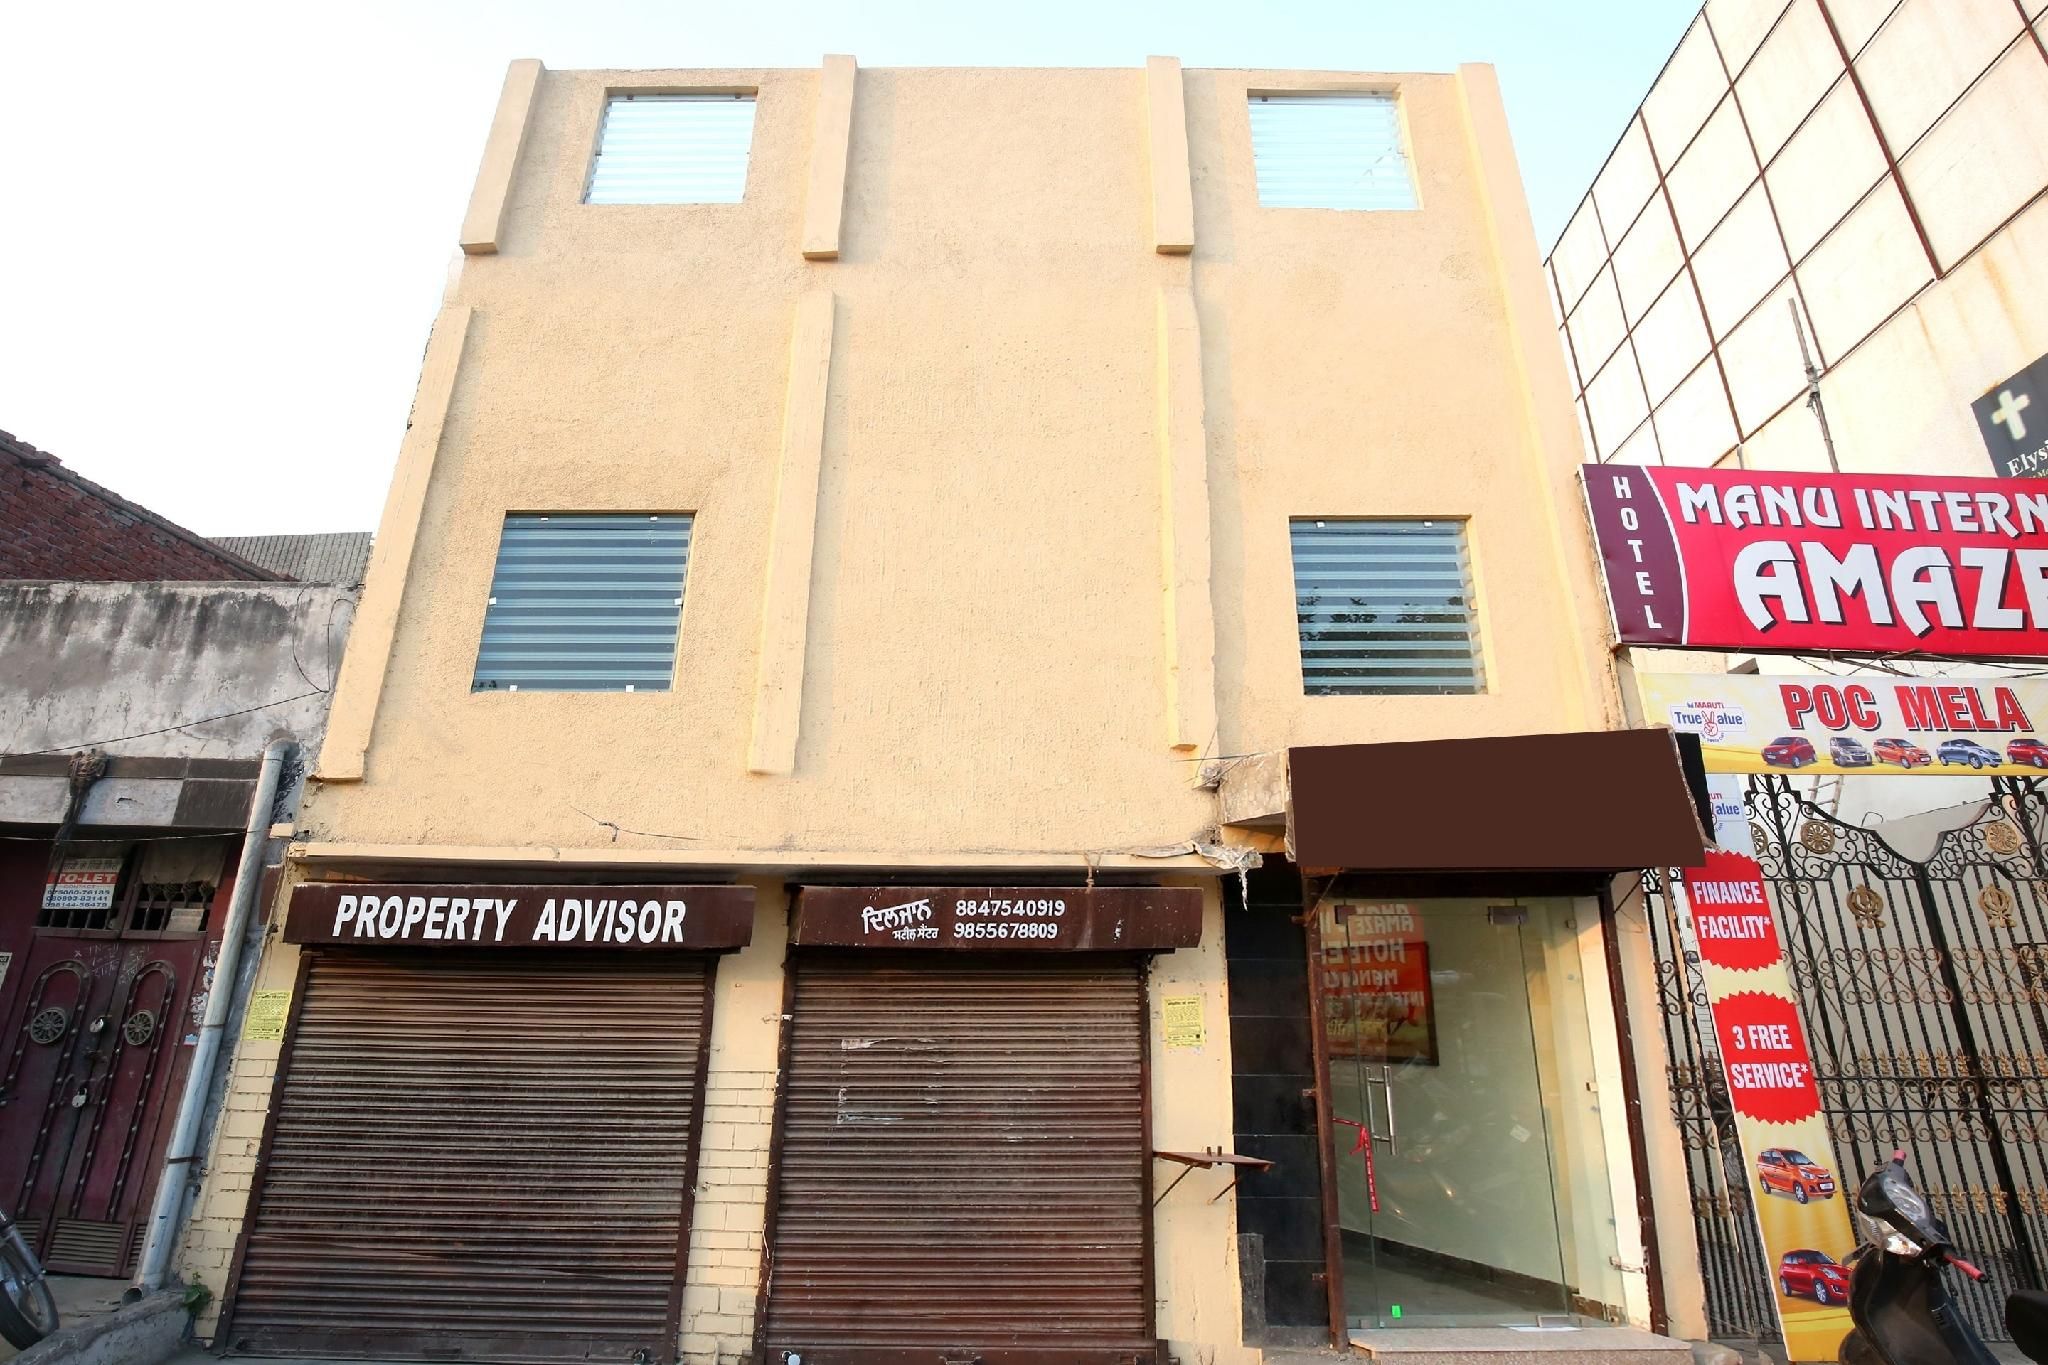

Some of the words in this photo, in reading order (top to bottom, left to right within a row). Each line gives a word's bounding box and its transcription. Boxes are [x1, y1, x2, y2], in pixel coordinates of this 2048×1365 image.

[2006, 440, 2048, 477] Elys
[1675, 482, 1842, 528] MANU
[1612, 475, 1663, 629] HOTEL
[1674, 711, 1703, 724] True
[1694, 701, 1725, 709] MARUTI
[1779, 684, 1881, 731] POC
[1893, 685, 2034, 732] MELA
[1691, 881, 1764, 904] FINANCE
[331, 895, 518, 942] PROPERTY
[532, 898, 686, 944] ADVISOR
[955, 899, 1066, 917] 8847540919
[953, 922, 1058, 939] 9855678809
[1731, 1024, 1746, 1050] 3
[1747, 1024, 1793, 1050] FREE
